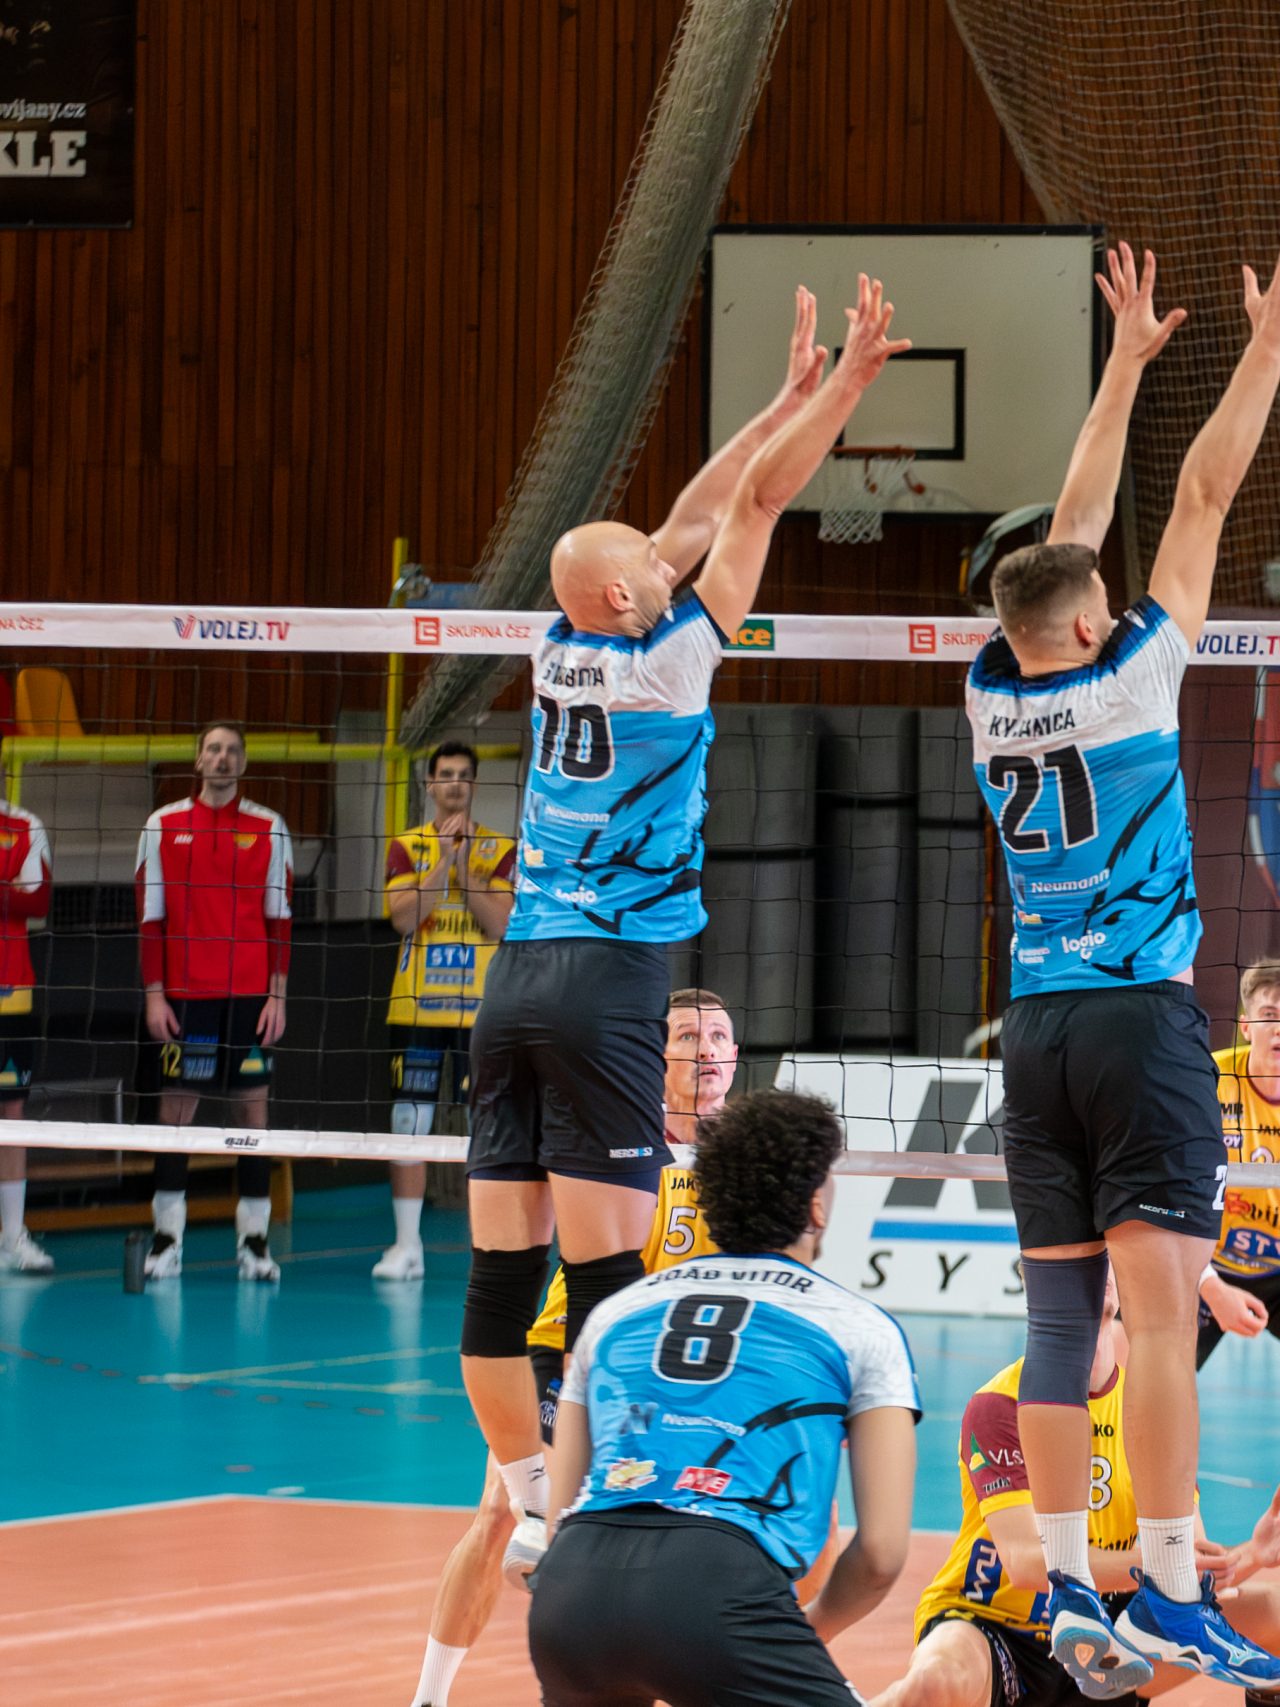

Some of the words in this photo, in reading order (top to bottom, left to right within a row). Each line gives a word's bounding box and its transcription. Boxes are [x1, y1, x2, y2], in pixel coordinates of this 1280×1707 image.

[18, 615, 45, 631] ČEZ
[200, 620, 290, 641] VOLEJ.TV
[445, 623, 503, 638] SKUPINA
[505, 622, 532, 638] ČEZ
[942, 633, 990, 647] SKUPIN
[534, 694, 616, 782] 10
[987, 744, 1099, 853] 21
[1031, 868, 1111, 893] Neumann
[671, 1177, 697, 1191] JAK
[663, 1206, 698, 1256] 5
[652, 1294, 756, 1385] 8
